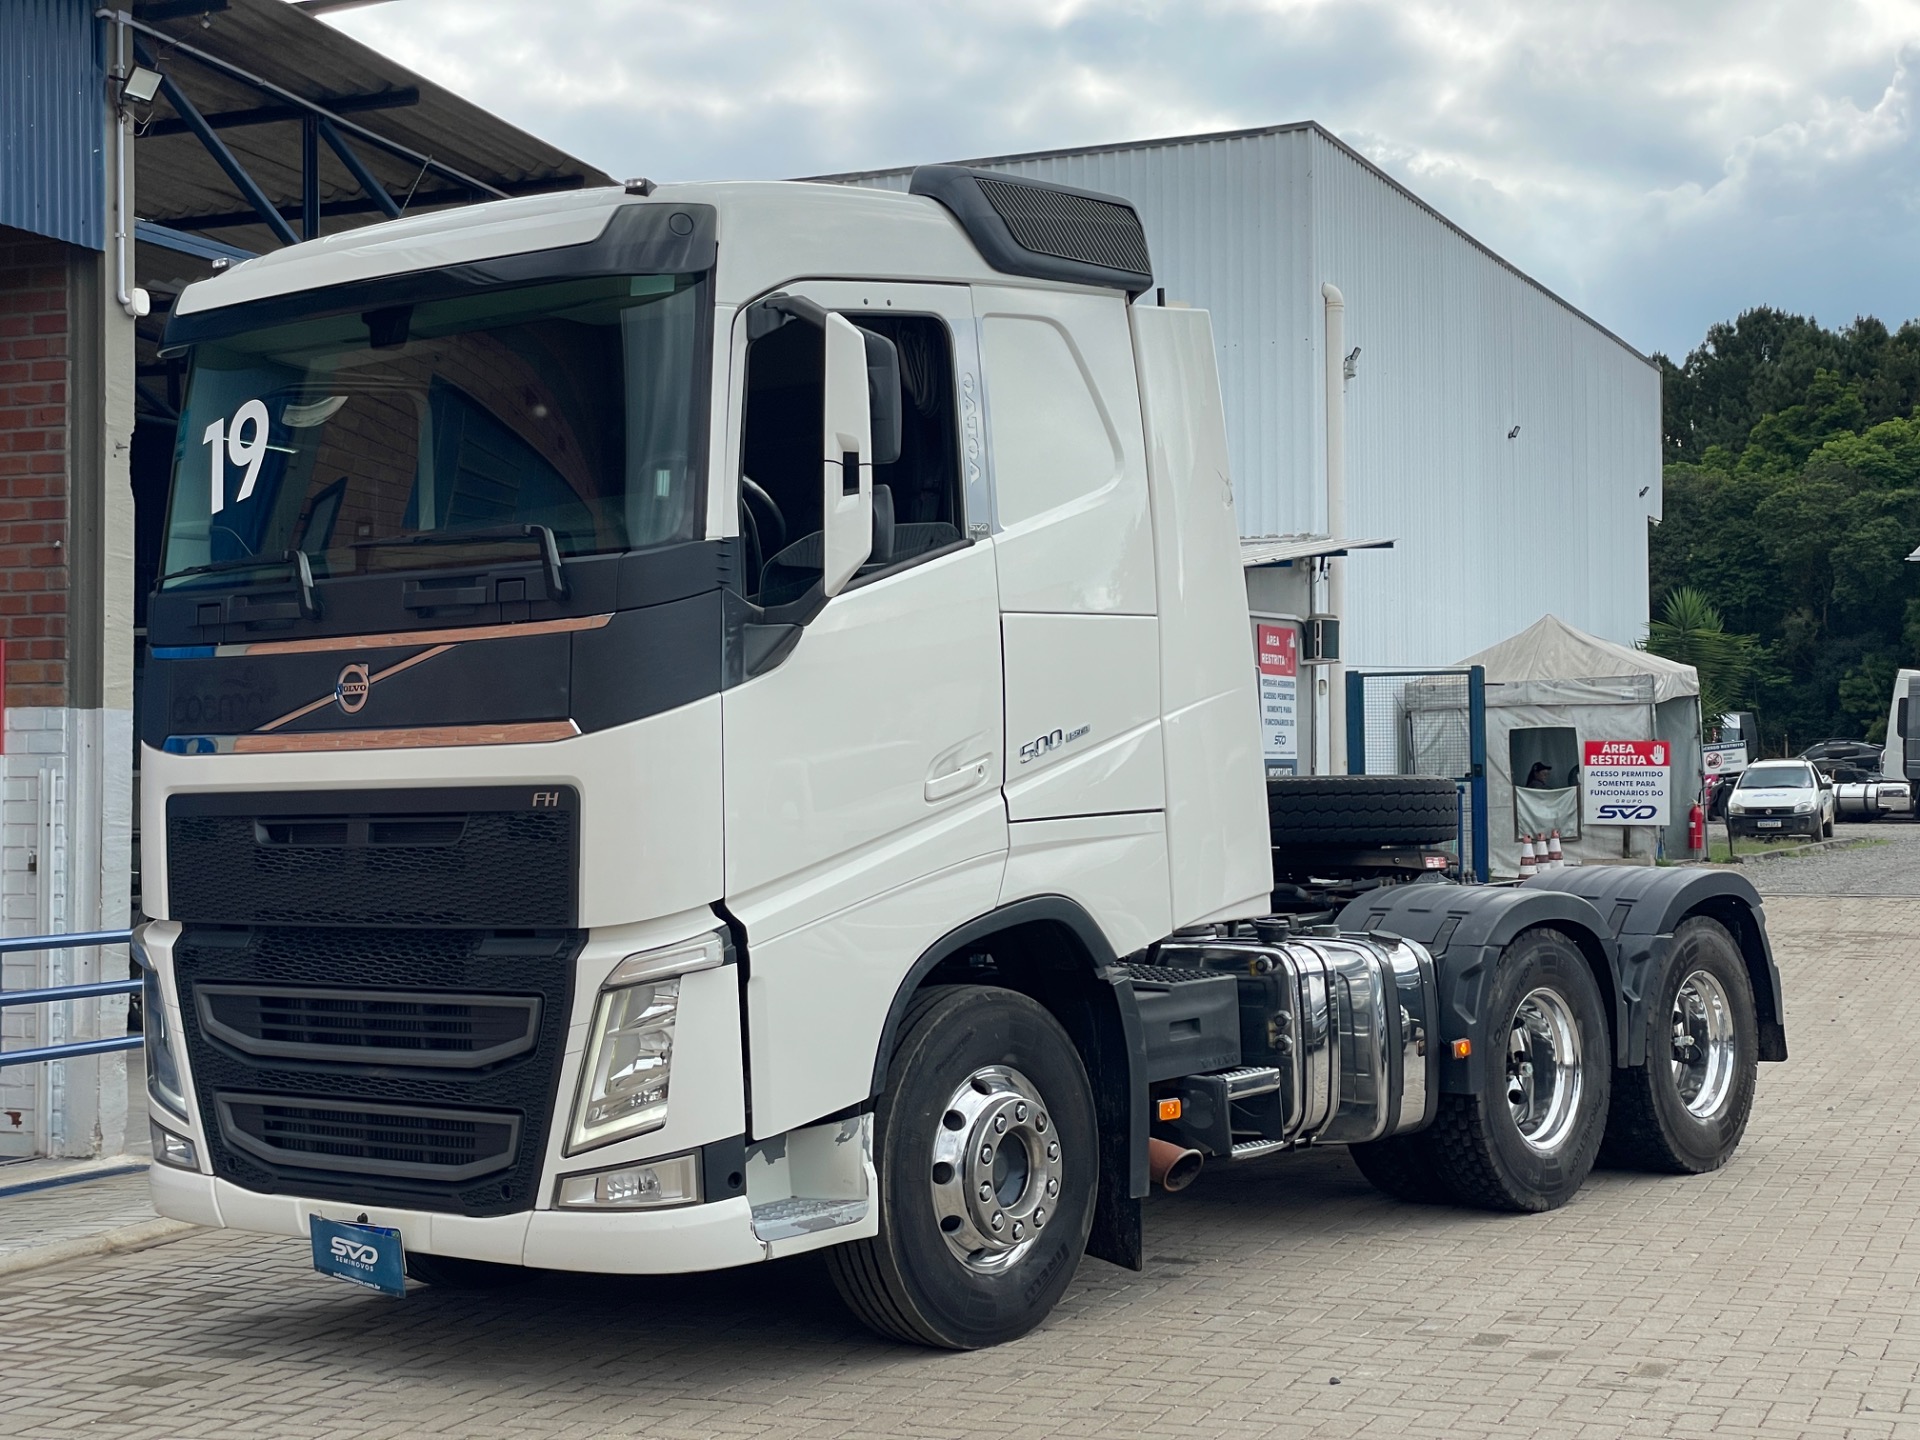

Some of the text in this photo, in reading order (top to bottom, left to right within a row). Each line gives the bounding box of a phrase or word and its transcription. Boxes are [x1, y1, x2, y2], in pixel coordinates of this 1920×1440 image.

[963, 371, 981, 485] VOLVO
[202, 399, 270, 515] 19
[1261, 653, 1286, 666] RESTRITA
[1020, 729, 1063, 764] 500
[1602, 742, 1635, 754] ÁREA
[1590, 755, 1647, 765] RESTRITA
[532, 792, 559, 807] FH
[1596, 805, 1658, 819] SVD
[330, 1236, 379, 1265] SVD
[335, 1255, 374, 1272] SEMINOVOS
